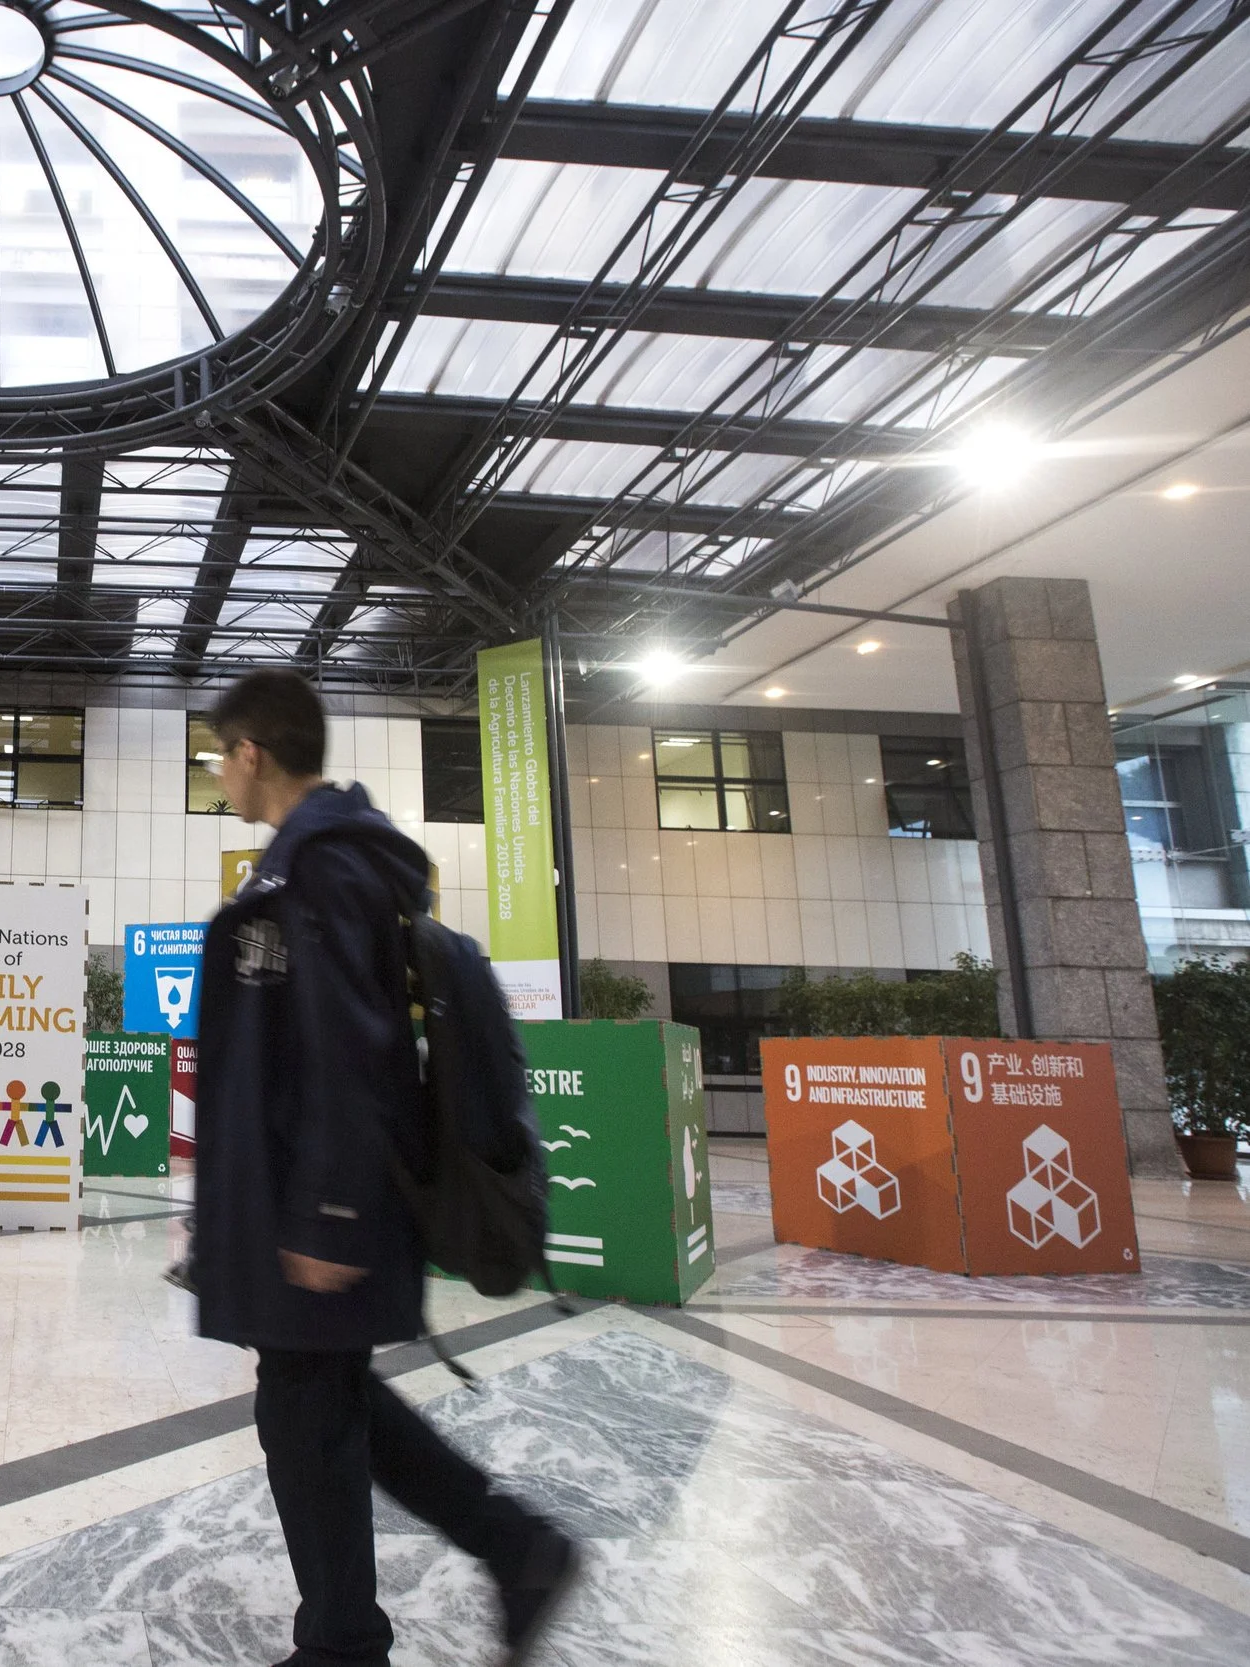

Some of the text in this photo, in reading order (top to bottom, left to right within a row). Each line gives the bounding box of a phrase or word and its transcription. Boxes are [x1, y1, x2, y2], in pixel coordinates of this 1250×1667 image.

[520, 672, 540, 826] Lanzamiento Global del
[504, 675, 526, 884] Decenio de las Naciones Unidas
[488, 678, 512, 920] de la Agricultura Familiar 2019-2028
[134, 930, 146, 956] 6
[151, 930, 204, 942] ЧИСТАЯ ВОДА
[4, 951, 24, 966] of
[150, 944, 203, 955] И САНИТАРИЯ
[113, 1041, 166, 1057] ЗДОРОВЬЕ
[86, 1058, 154, 1073] АГОПОЛУЧИЕ
[806, 1065, 926, 1086] INDUSTRY, INNOVATION
[960, 1051, 984, 1104] 9
[986, 1052, 1084, 1078] 产业、创新和
[785, 1064, 802, 1102] 9
[990, 1082, 1062, 1107] 基础设施
[809, 1086, 927, 1109] AND INFRASTRUCTURE
